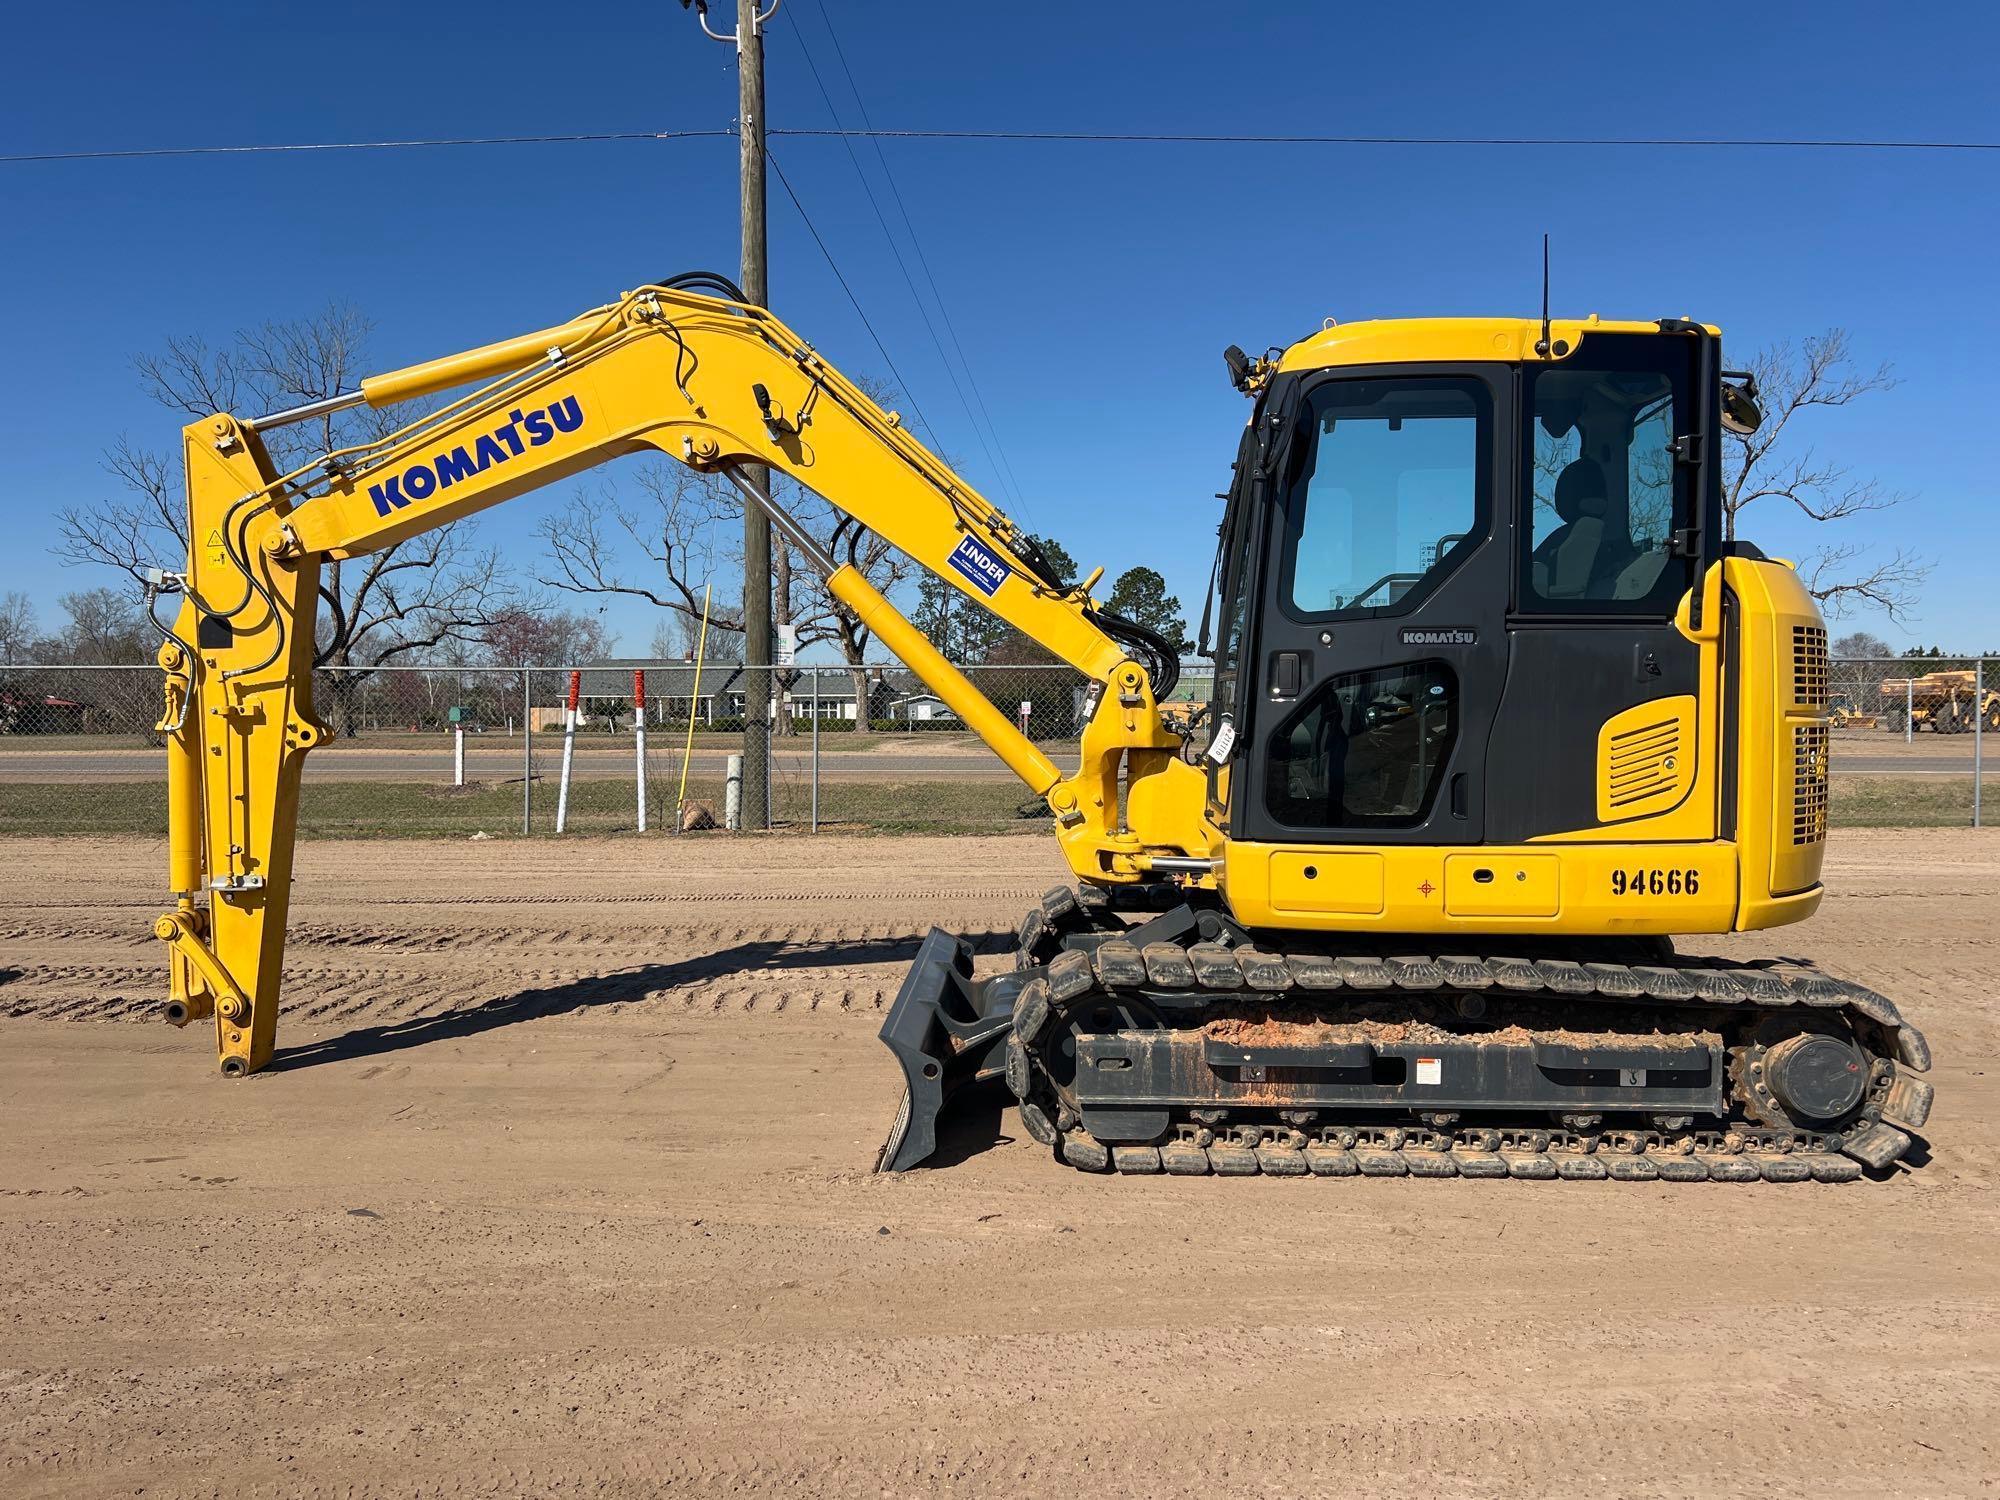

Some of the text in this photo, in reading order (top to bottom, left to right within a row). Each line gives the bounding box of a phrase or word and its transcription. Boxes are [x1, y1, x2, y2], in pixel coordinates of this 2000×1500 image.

[367, 395, 584, 517] KOMATSU
[959, 540, 1005, 583] LINDER
[1403, 629, 1474, 643] KOMATSU
[1612, 869, 1699, 895] 94666
